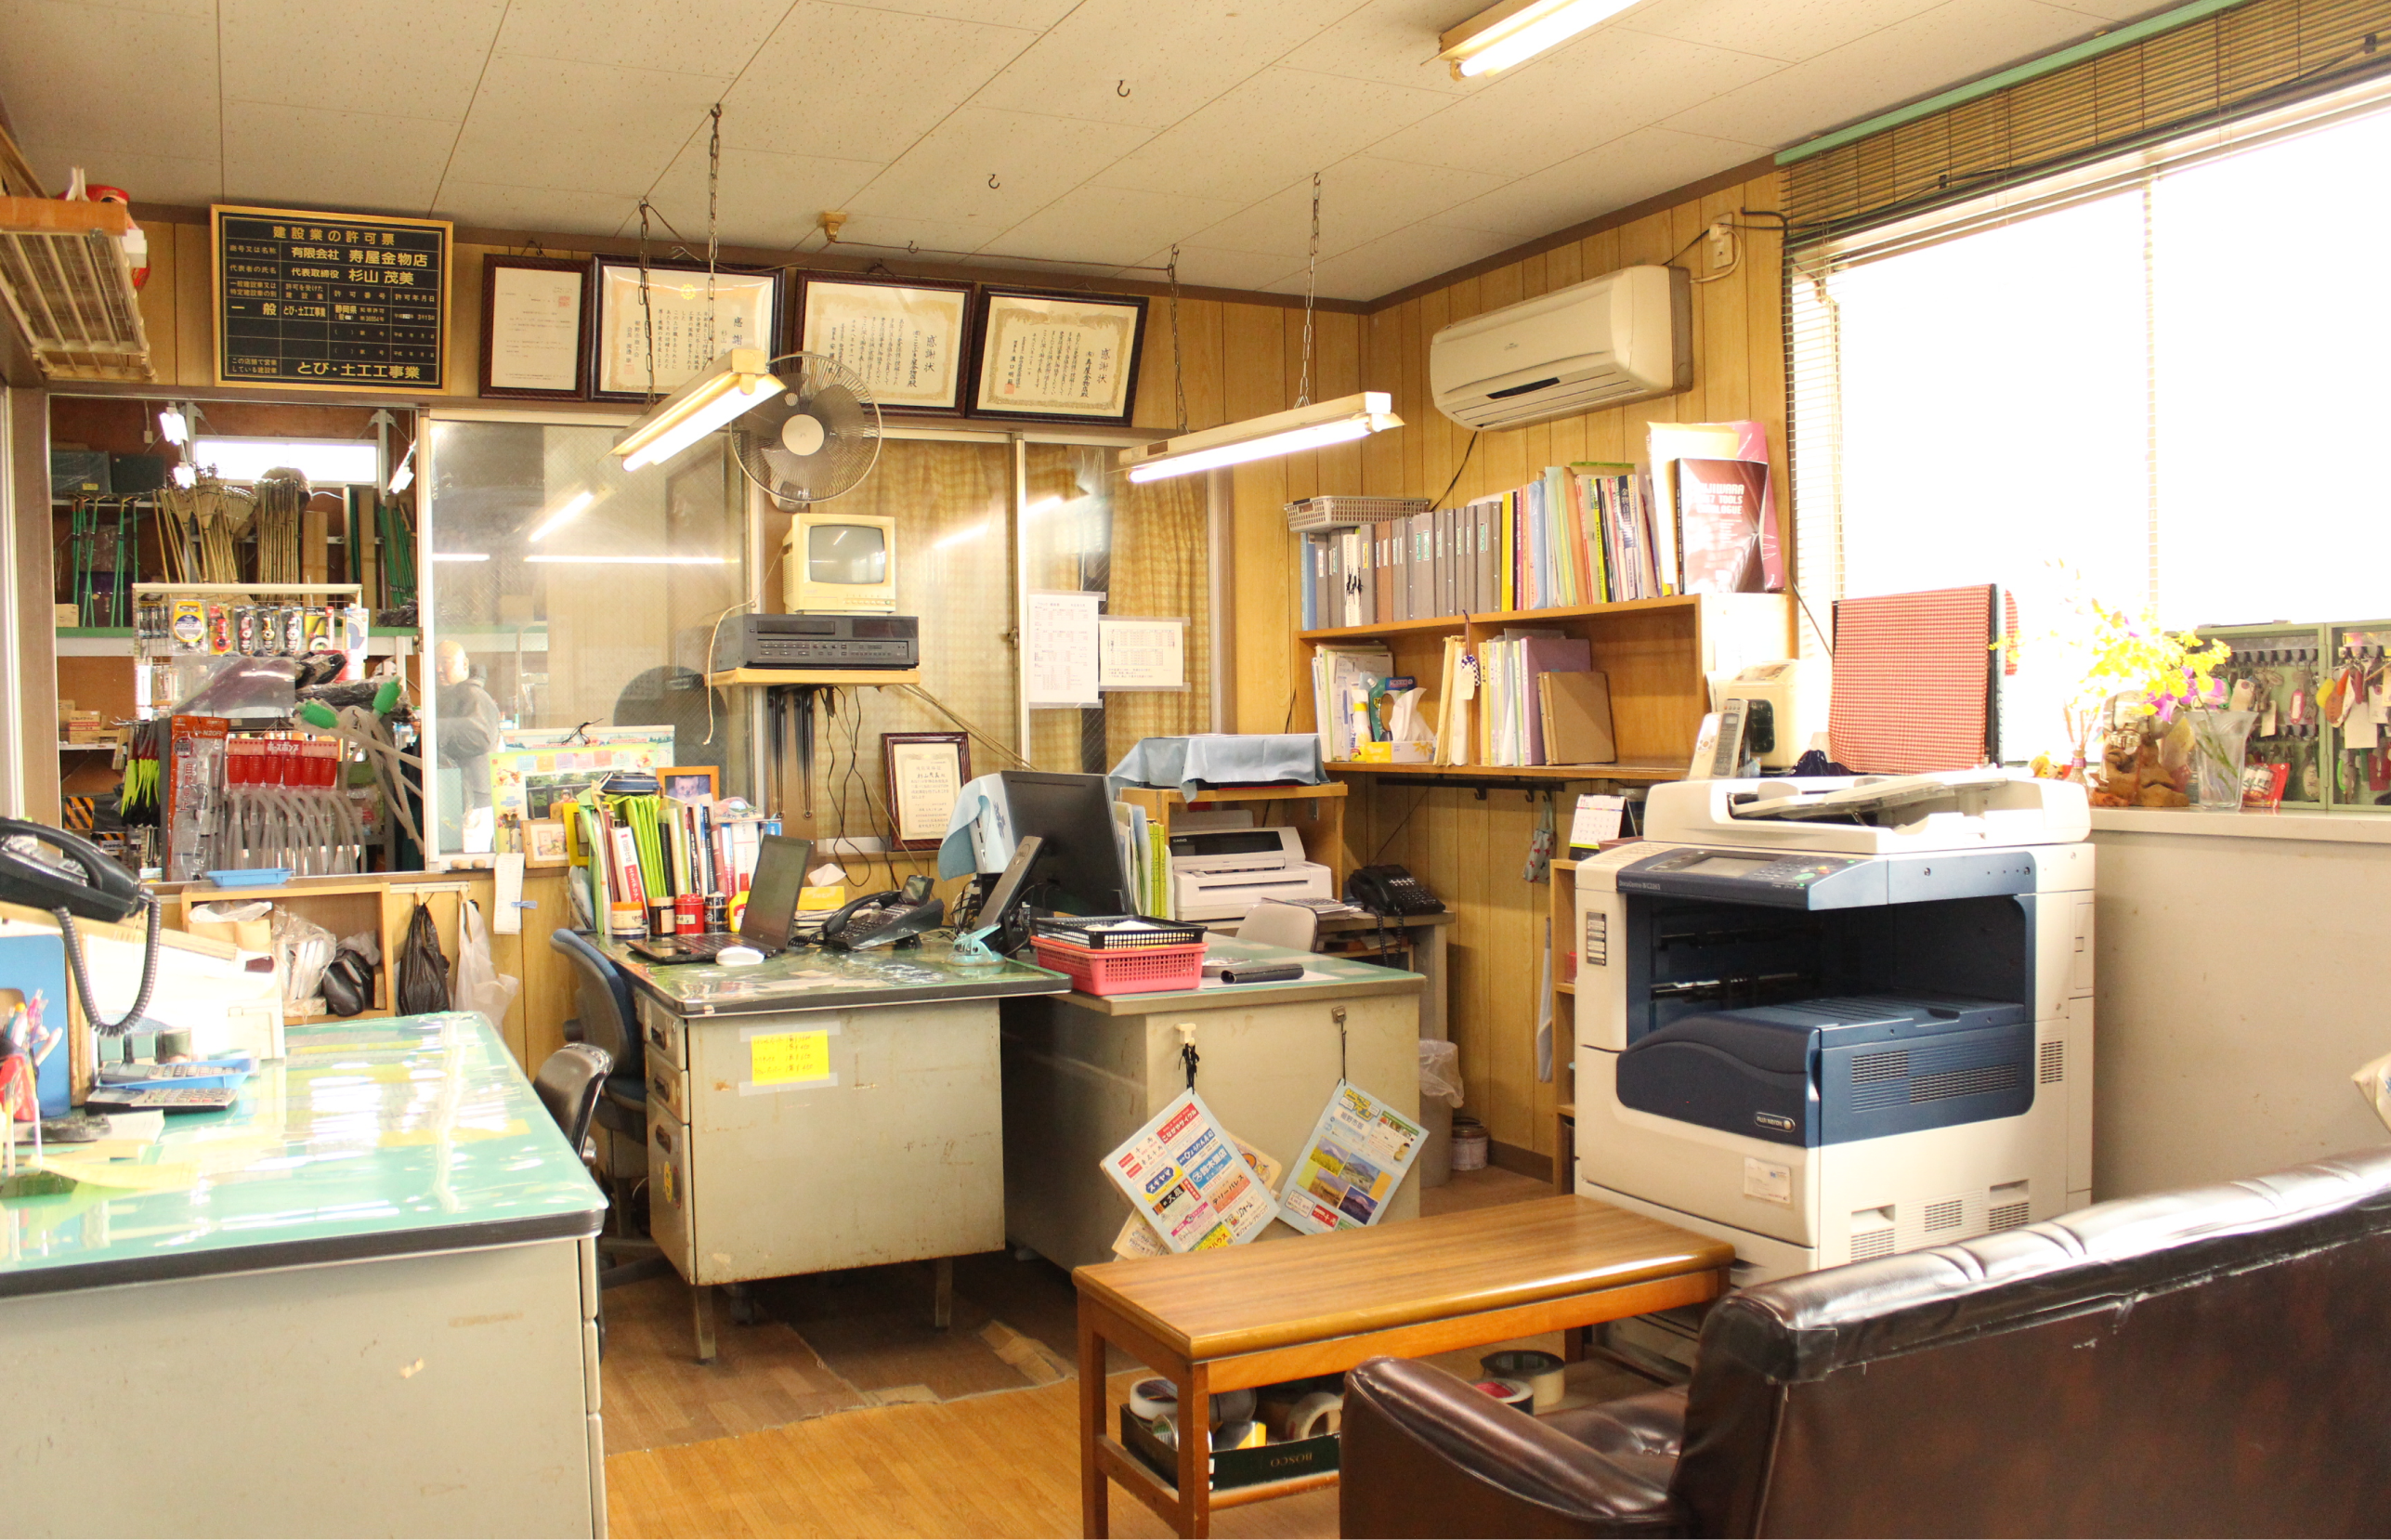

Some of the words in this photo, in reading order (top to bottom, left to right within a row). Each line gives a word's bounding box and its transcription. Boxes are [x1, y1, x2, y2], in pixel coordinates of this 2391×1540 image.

[273, 226, 395, 246] 建設業の許可票
[229, 244, 277, 254] 商号又は名称
[291, 246, 340, 261] 有限会社
[348, 249, 428, 267] 寿屋金物店
[229, 264, 277, 274] 代表者の氏名
[291, 267, 339, 279] 代表取締役
[348, 268, 378, 283] 杉山
[384, 270, 414, 285] 茂美
[923, 334, 937, 372] 感謝状
[297, 361, 420, 379] とび・土工工事業
[1096, 347, 1111, 384] 感謝状
[1718, 495, 1744, 504] TOOLS
[1271, 1452, 1313, 1468] BOSCO
